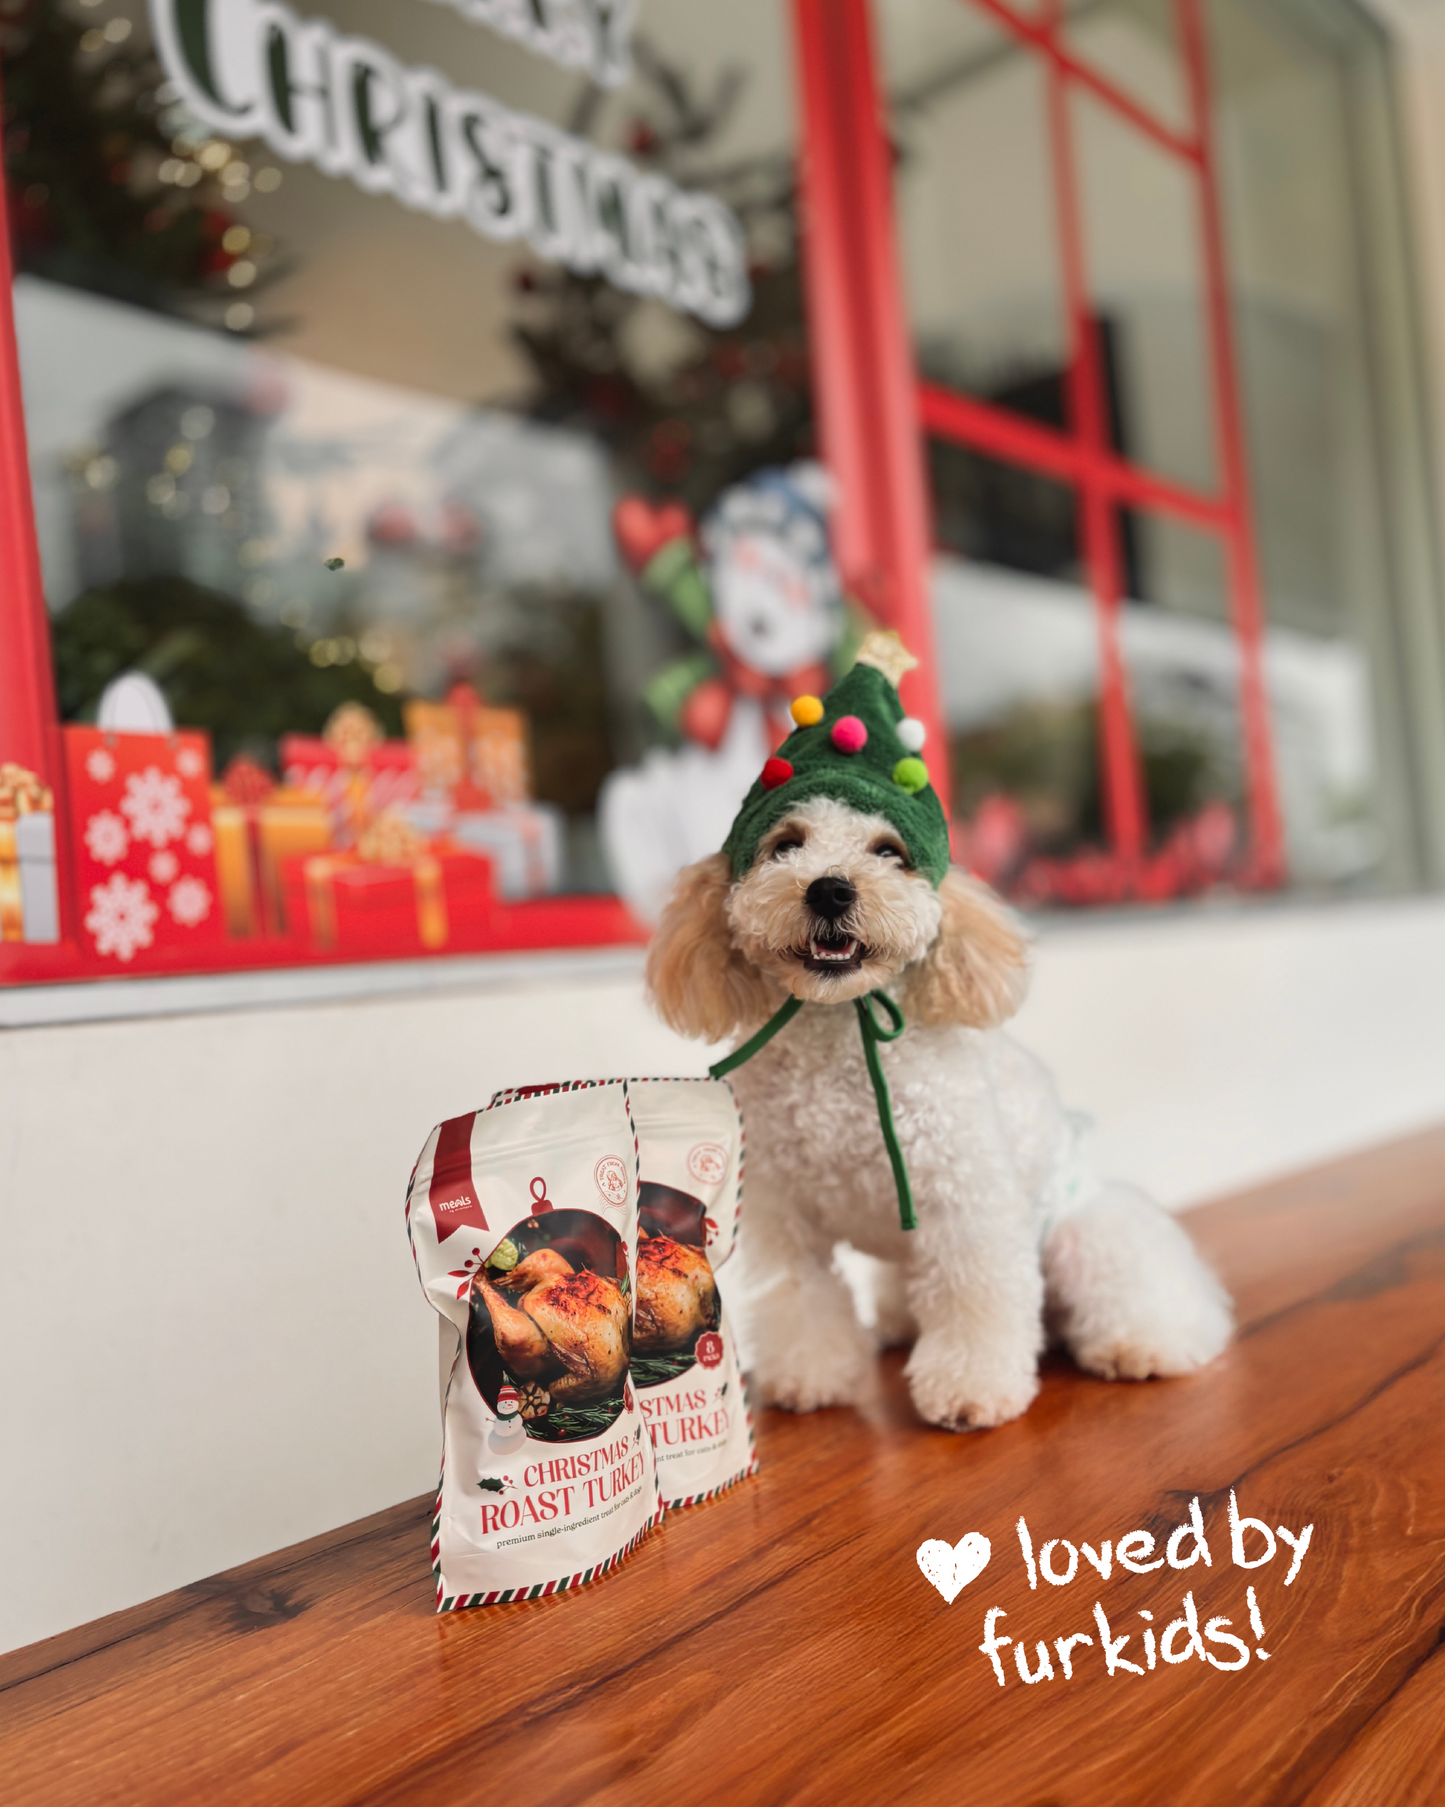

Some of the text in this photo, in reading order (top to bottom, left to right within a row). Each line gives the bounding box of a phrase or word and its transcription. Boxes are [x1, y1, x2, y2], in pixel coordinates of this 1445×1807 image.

[439, 1196, 471, 1211] meals
[706, 1340, 715, 1354] 8
[523, 1435, 629, 1488] CHRISTMAS
[666, 1452, 683, 1461] treat
[685, 1449, 695, 1457] for
[480, 1451, 644, 1535] ROAST TURKEY
[496, 1533, 536, 1549] premium
[537, 1514, 600, 1539] single-ingredient
[601, 1507, 614, 1519] treat
